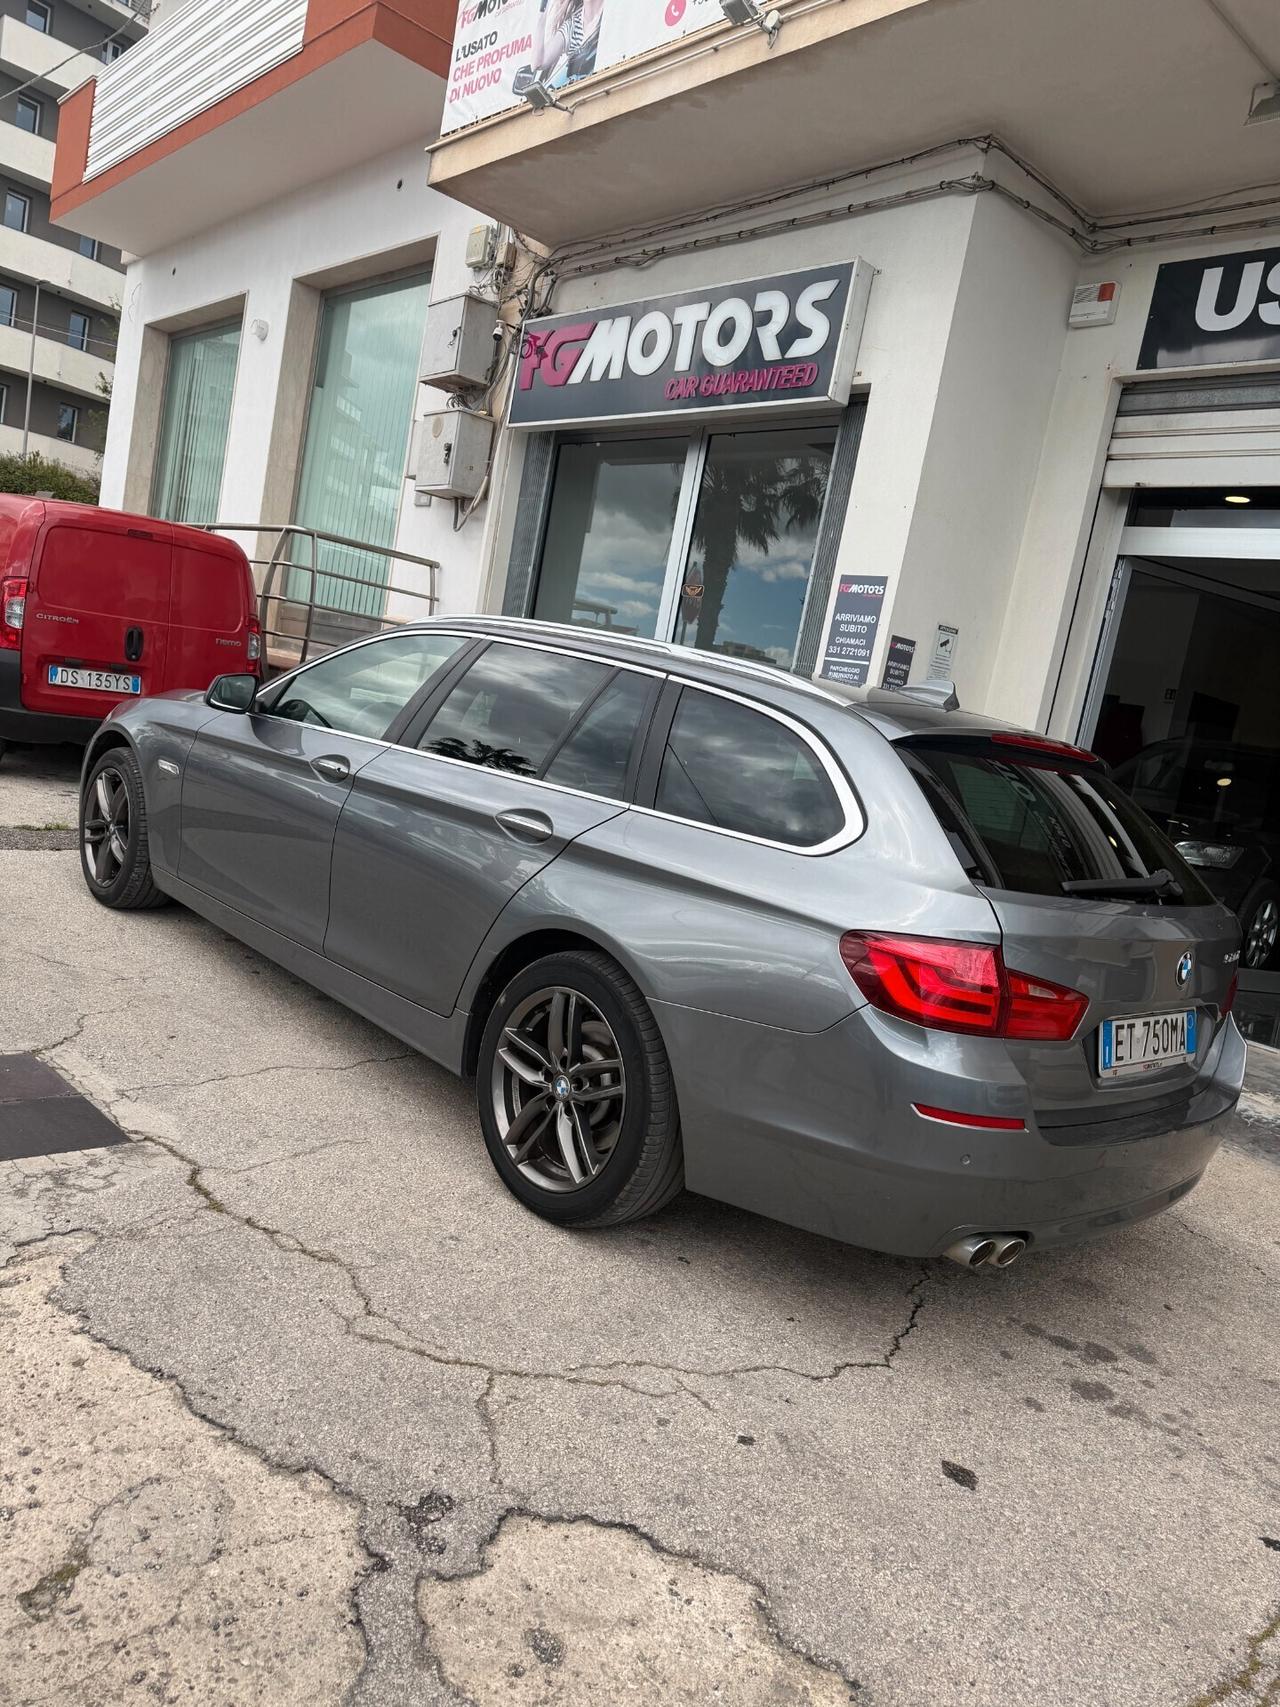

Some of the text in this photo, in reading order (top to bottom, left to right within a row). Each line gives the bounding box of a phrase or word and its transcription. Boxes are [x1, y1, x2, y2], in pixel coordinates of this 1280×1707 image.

[453, 34, 532, 82] CHE PROFUMA
[455, 31, 498, 62] L'USATO
[449, 68, 502, 103] DI NUOVO
[519, 279, 840, 391] FGMOTORS
[664, 362, 820, 400] CAR GUARANTEED
[839, 583, 885, 595] FGMOTORS
[834, 613, 877, 624] ARRIVIAMO
[839, 623, 868, 634] SUBITO
[828, 645, 870, 657] 331 2721091
[835, 636, 866, 646] CHIAMACI
[60, 669, 130, 691] DS 135YS
[1115, 1016, 1186, 1062] ET 750MA
